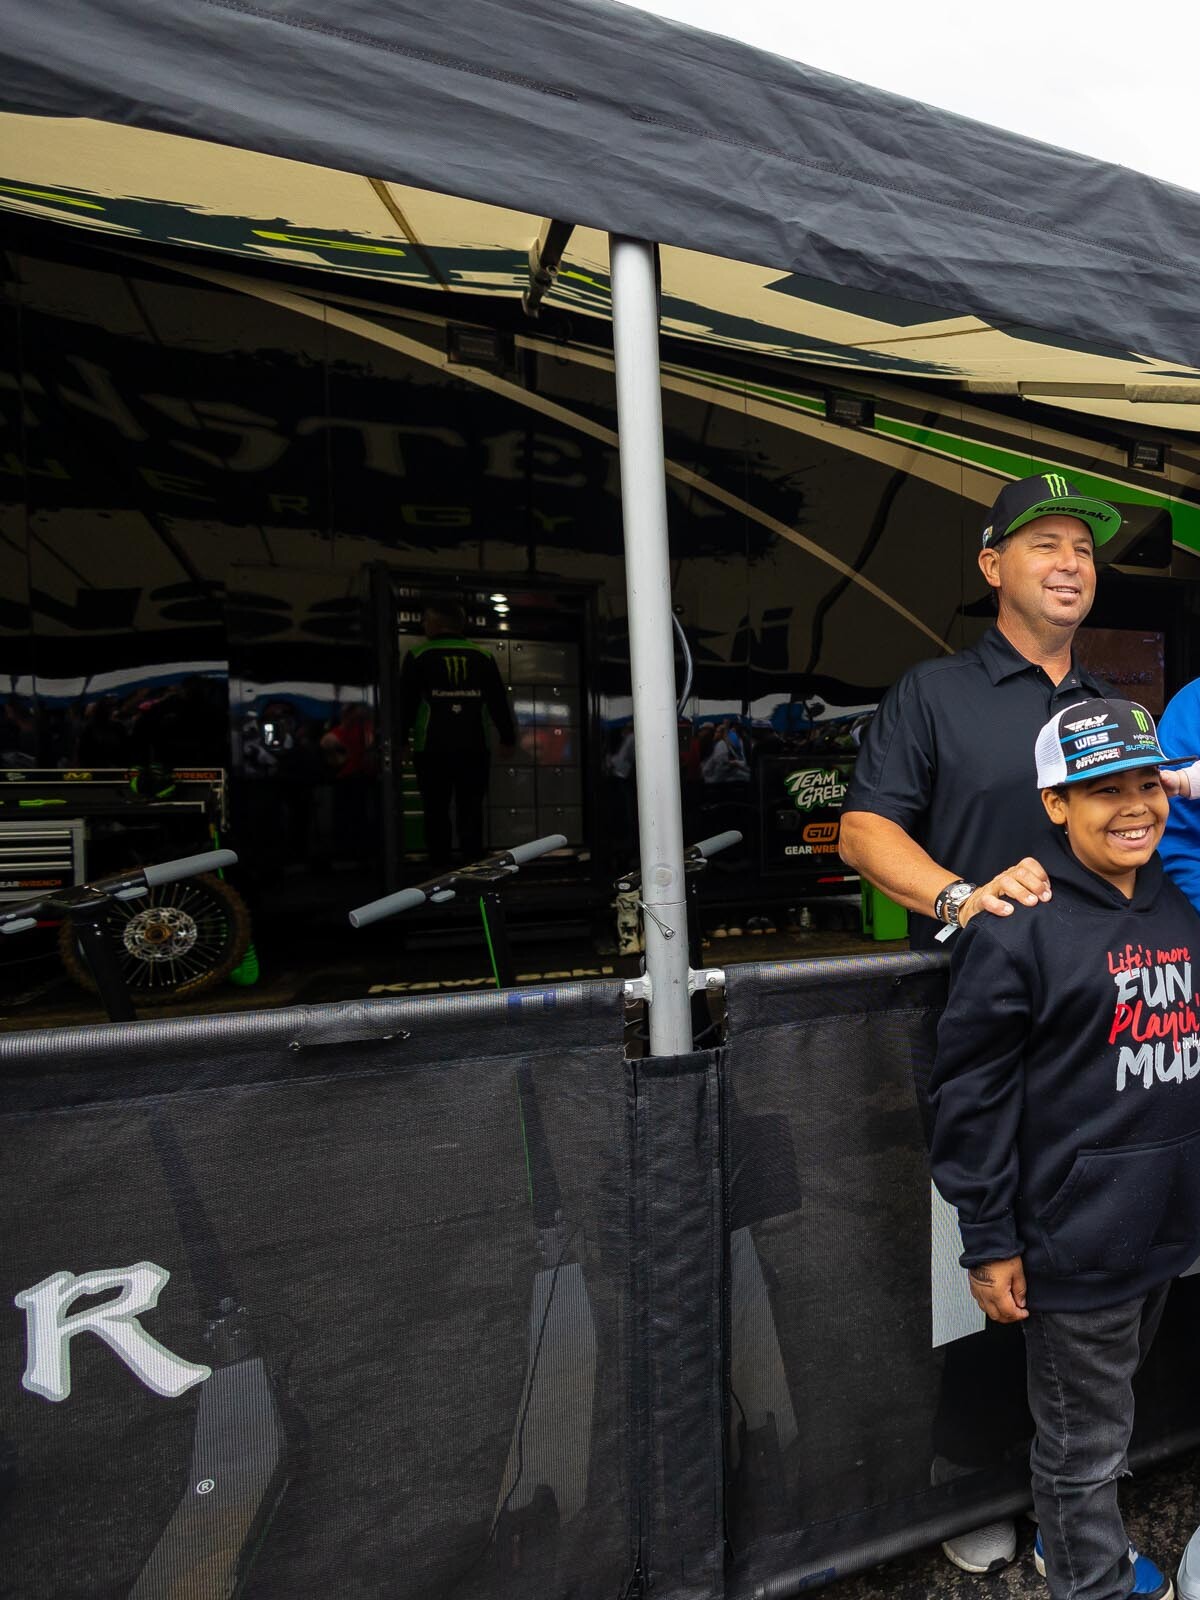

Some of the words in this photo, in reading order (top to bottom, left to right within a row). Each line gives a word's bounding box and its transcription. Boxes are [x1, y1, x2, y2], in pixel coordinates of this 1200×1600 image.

[1033, 505, 1112, 523] Kawasaki
[1074, 732, 1109, 750] WPS
[786, 769, 836, 792] TEAM
[1107, 944, 1152, 977] Life's
[1156, 947, 1191, 965] more
[1114, 961, 1193, 1018] FUN
